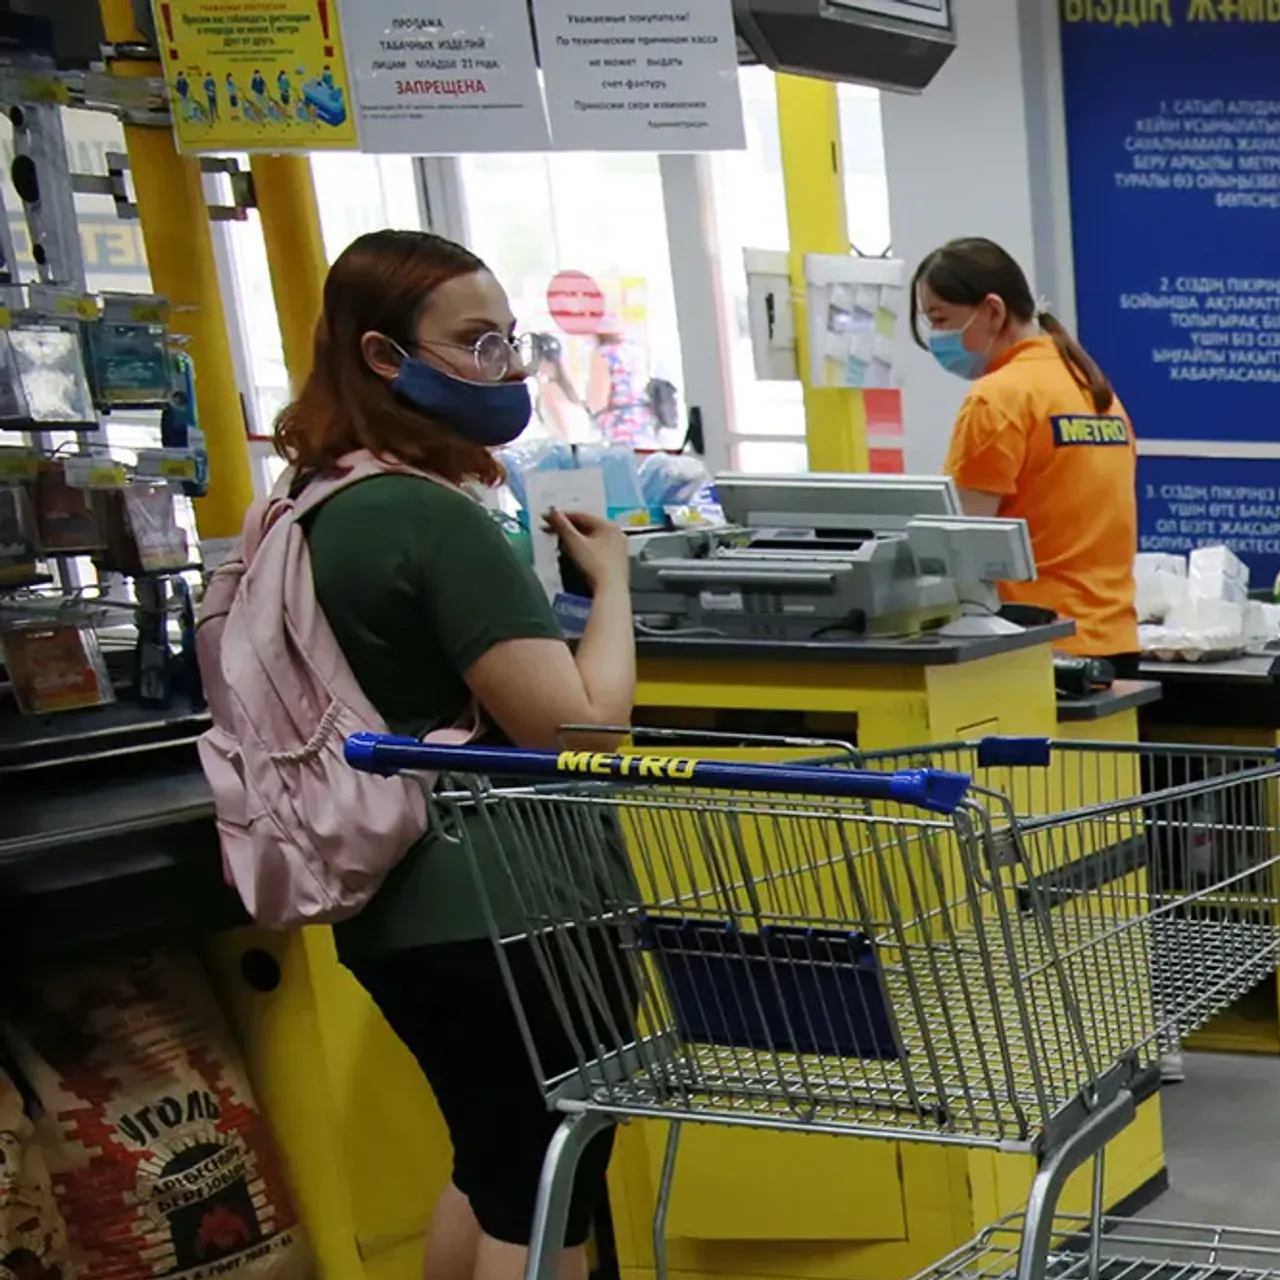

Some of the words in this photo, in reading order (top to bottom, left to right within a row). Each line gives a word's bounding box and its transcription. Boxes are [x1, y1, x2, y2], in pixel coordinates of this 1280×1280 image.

[392, 18, 444, 30] ПРОДАЖА
[438, 37, 486, 50] ИЗДЕЛИЙ
[395, 79, 487, 96] ЗАПРЕЩЕНА
[1058, 417, 1128, 444] METRO
[556, 748, 697, 780] METRO
[116, 1089, 220, 1147] УГОЛЬ
